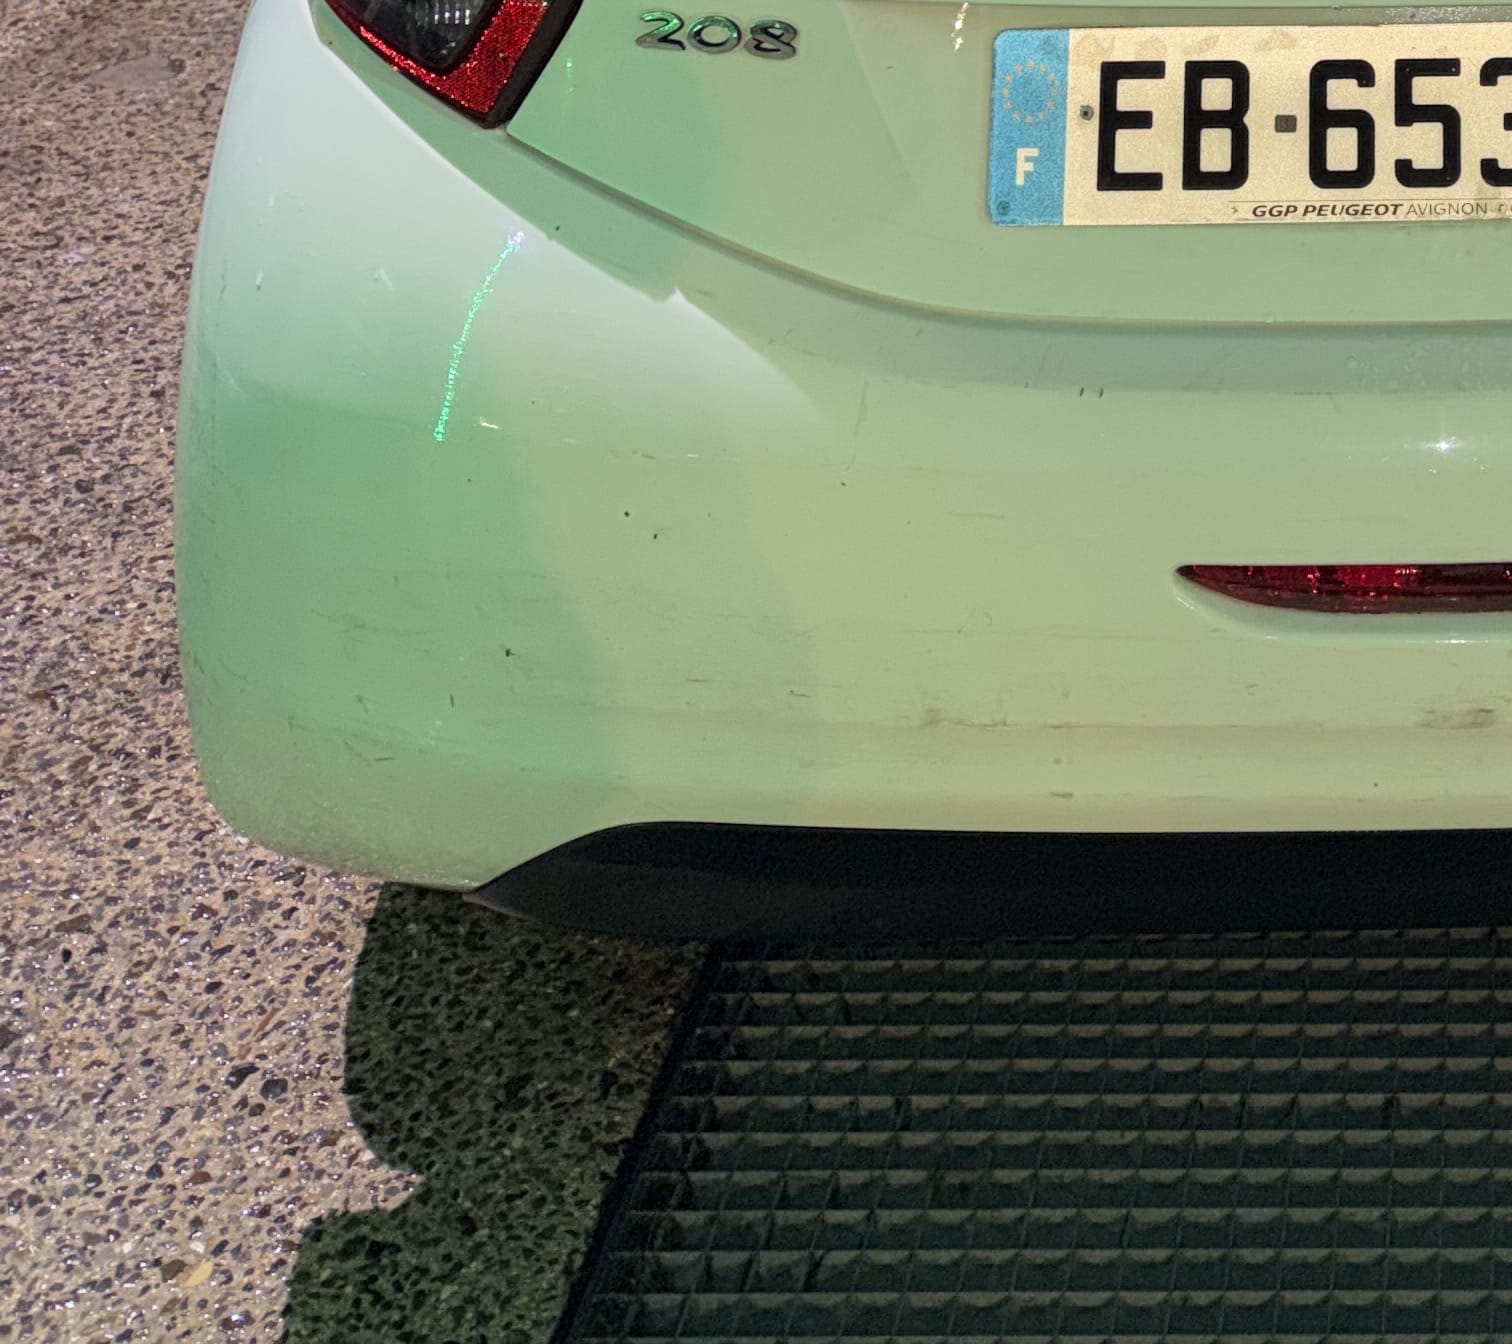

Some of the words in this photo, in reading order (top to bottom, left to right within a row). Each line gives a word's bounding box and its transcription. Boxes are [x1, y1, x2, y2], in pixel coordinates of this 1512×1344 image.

[635, 9, 801, 61] 208
[1015, 147, 1041, 187] F
[1251, 204, 1298, 218] GGP
[1302, 203, 1404, 218] PEUGEOT
[1407, 202, 1488, 216] AVIGNON
